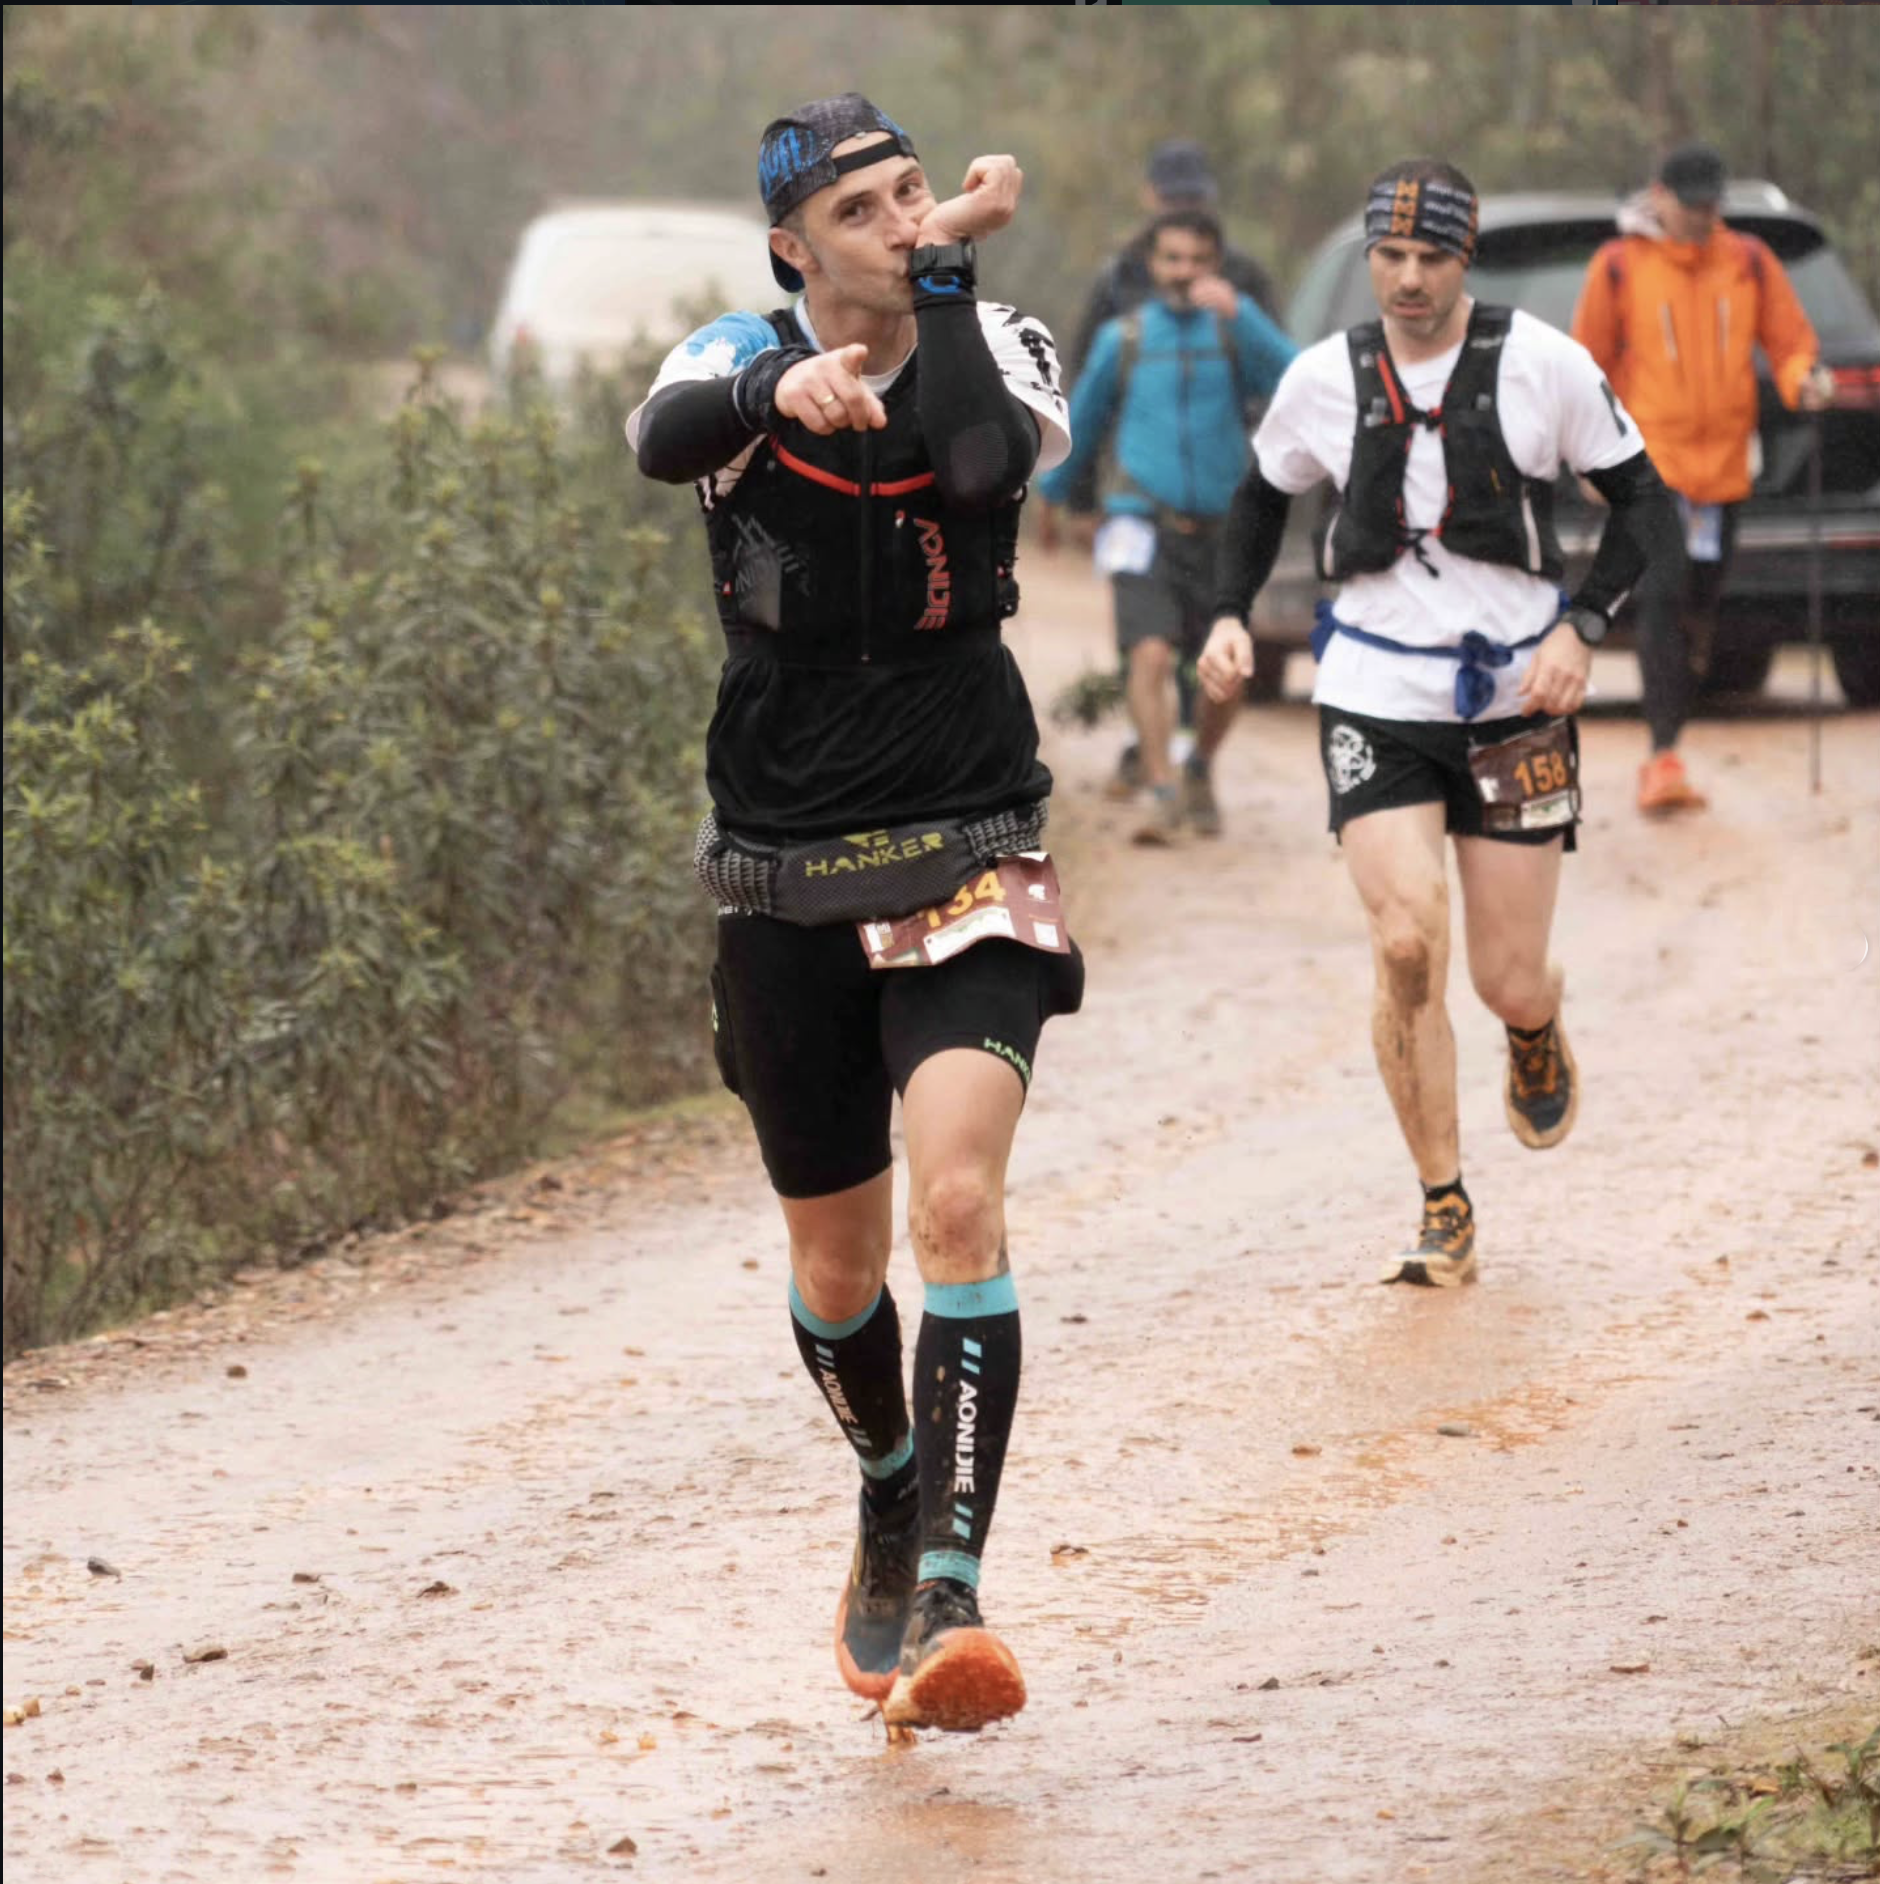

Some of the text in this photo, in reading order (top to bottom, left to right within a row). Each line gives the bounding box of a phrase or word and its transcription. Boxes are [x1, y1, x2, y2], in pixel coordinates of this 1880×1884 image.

[1514, 751, 1568, 797] 158
[805, 832, 945, 877] HANKER
[954, 1380, 978, 1494] AONIJIE
